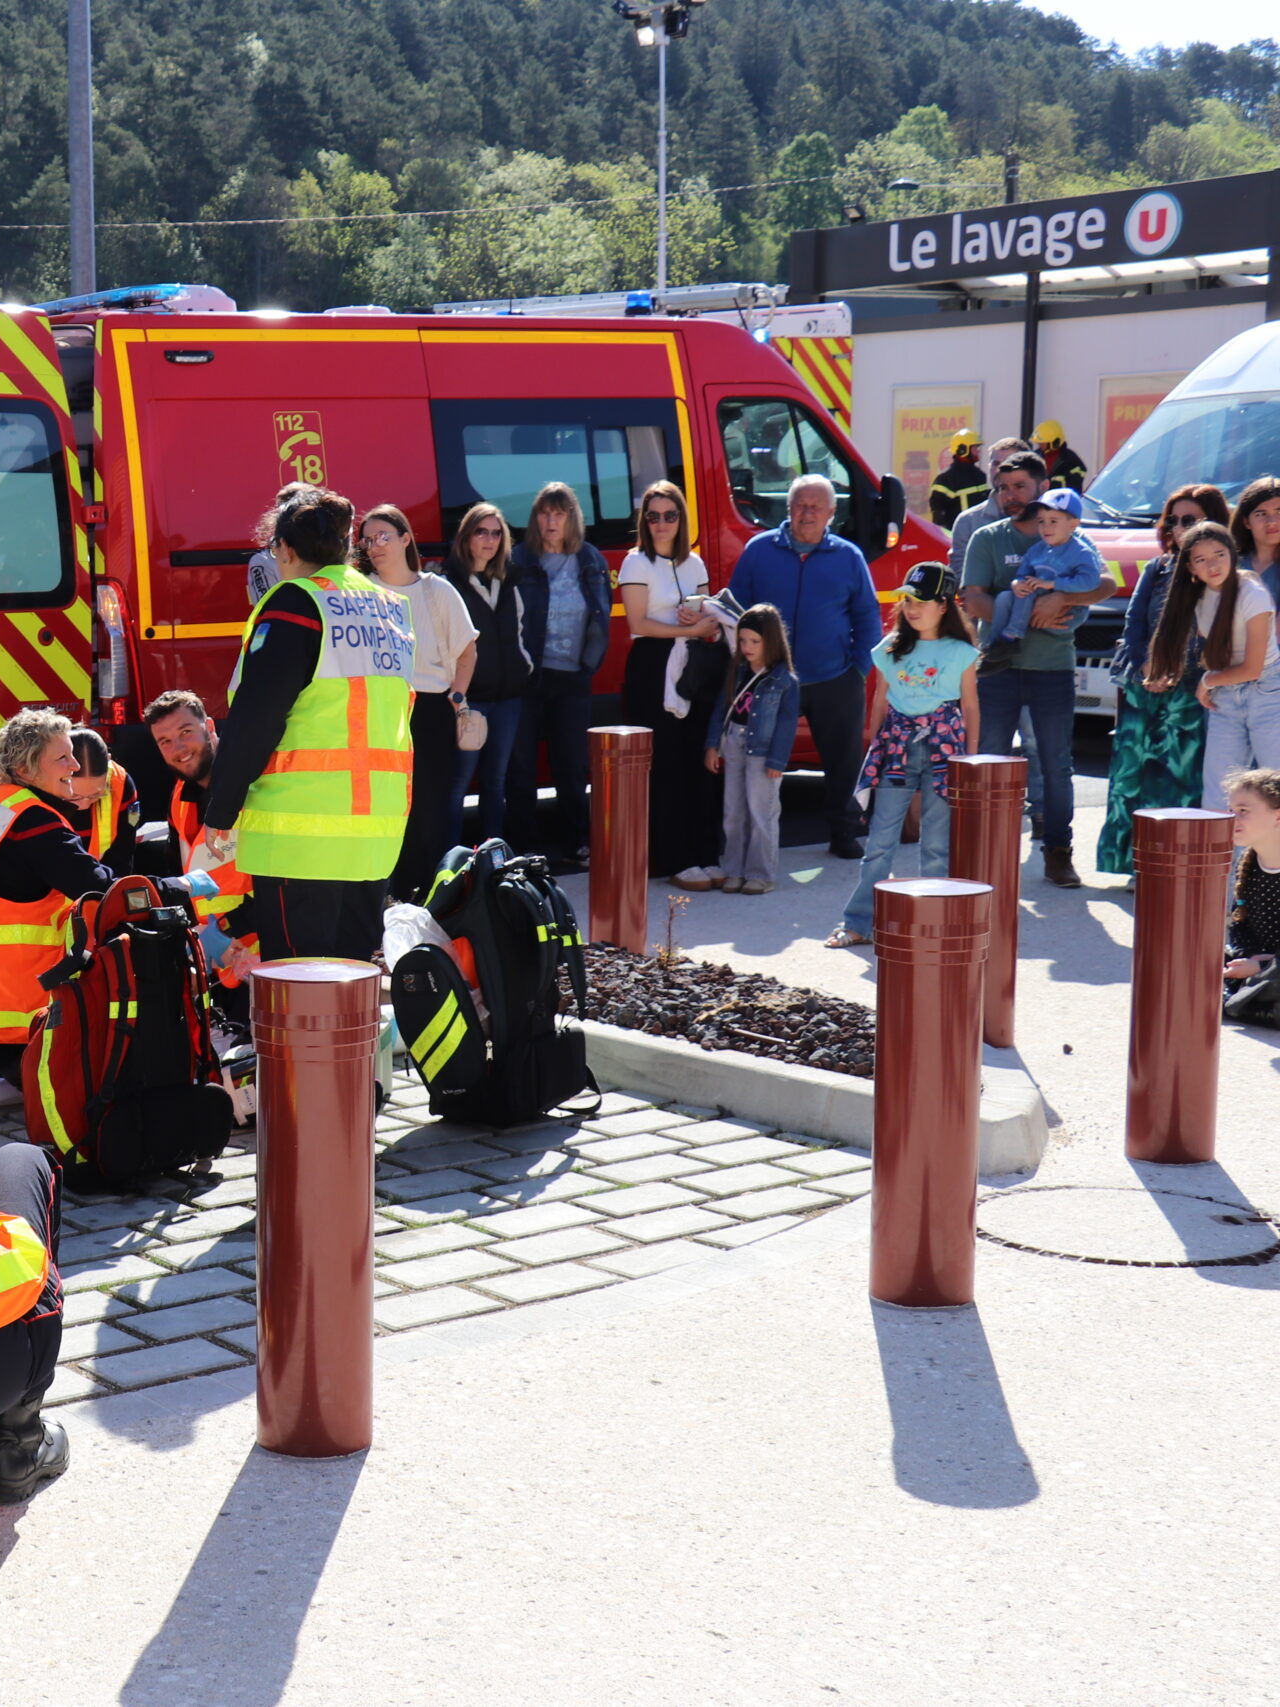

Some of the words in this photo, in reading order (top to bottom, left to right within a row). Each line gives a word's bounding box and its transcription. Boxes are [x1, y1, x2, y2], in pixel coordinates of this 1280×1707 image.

[889, 223, 937, 272] Le
[951, 207, 1106, 267] lavage
[1138, 208, 1168, 243] U
[276, 414, 305, 431] 112
[902, 416, 935, 432] PRIX
[938, 415, 967, 431] BAS
[290, 454, 324, 485] 18
[327, 596, 404, 625] SAPEURS
[331, 624, 413, 656] POMPIERS
[372, 651, 402, 671] COS
